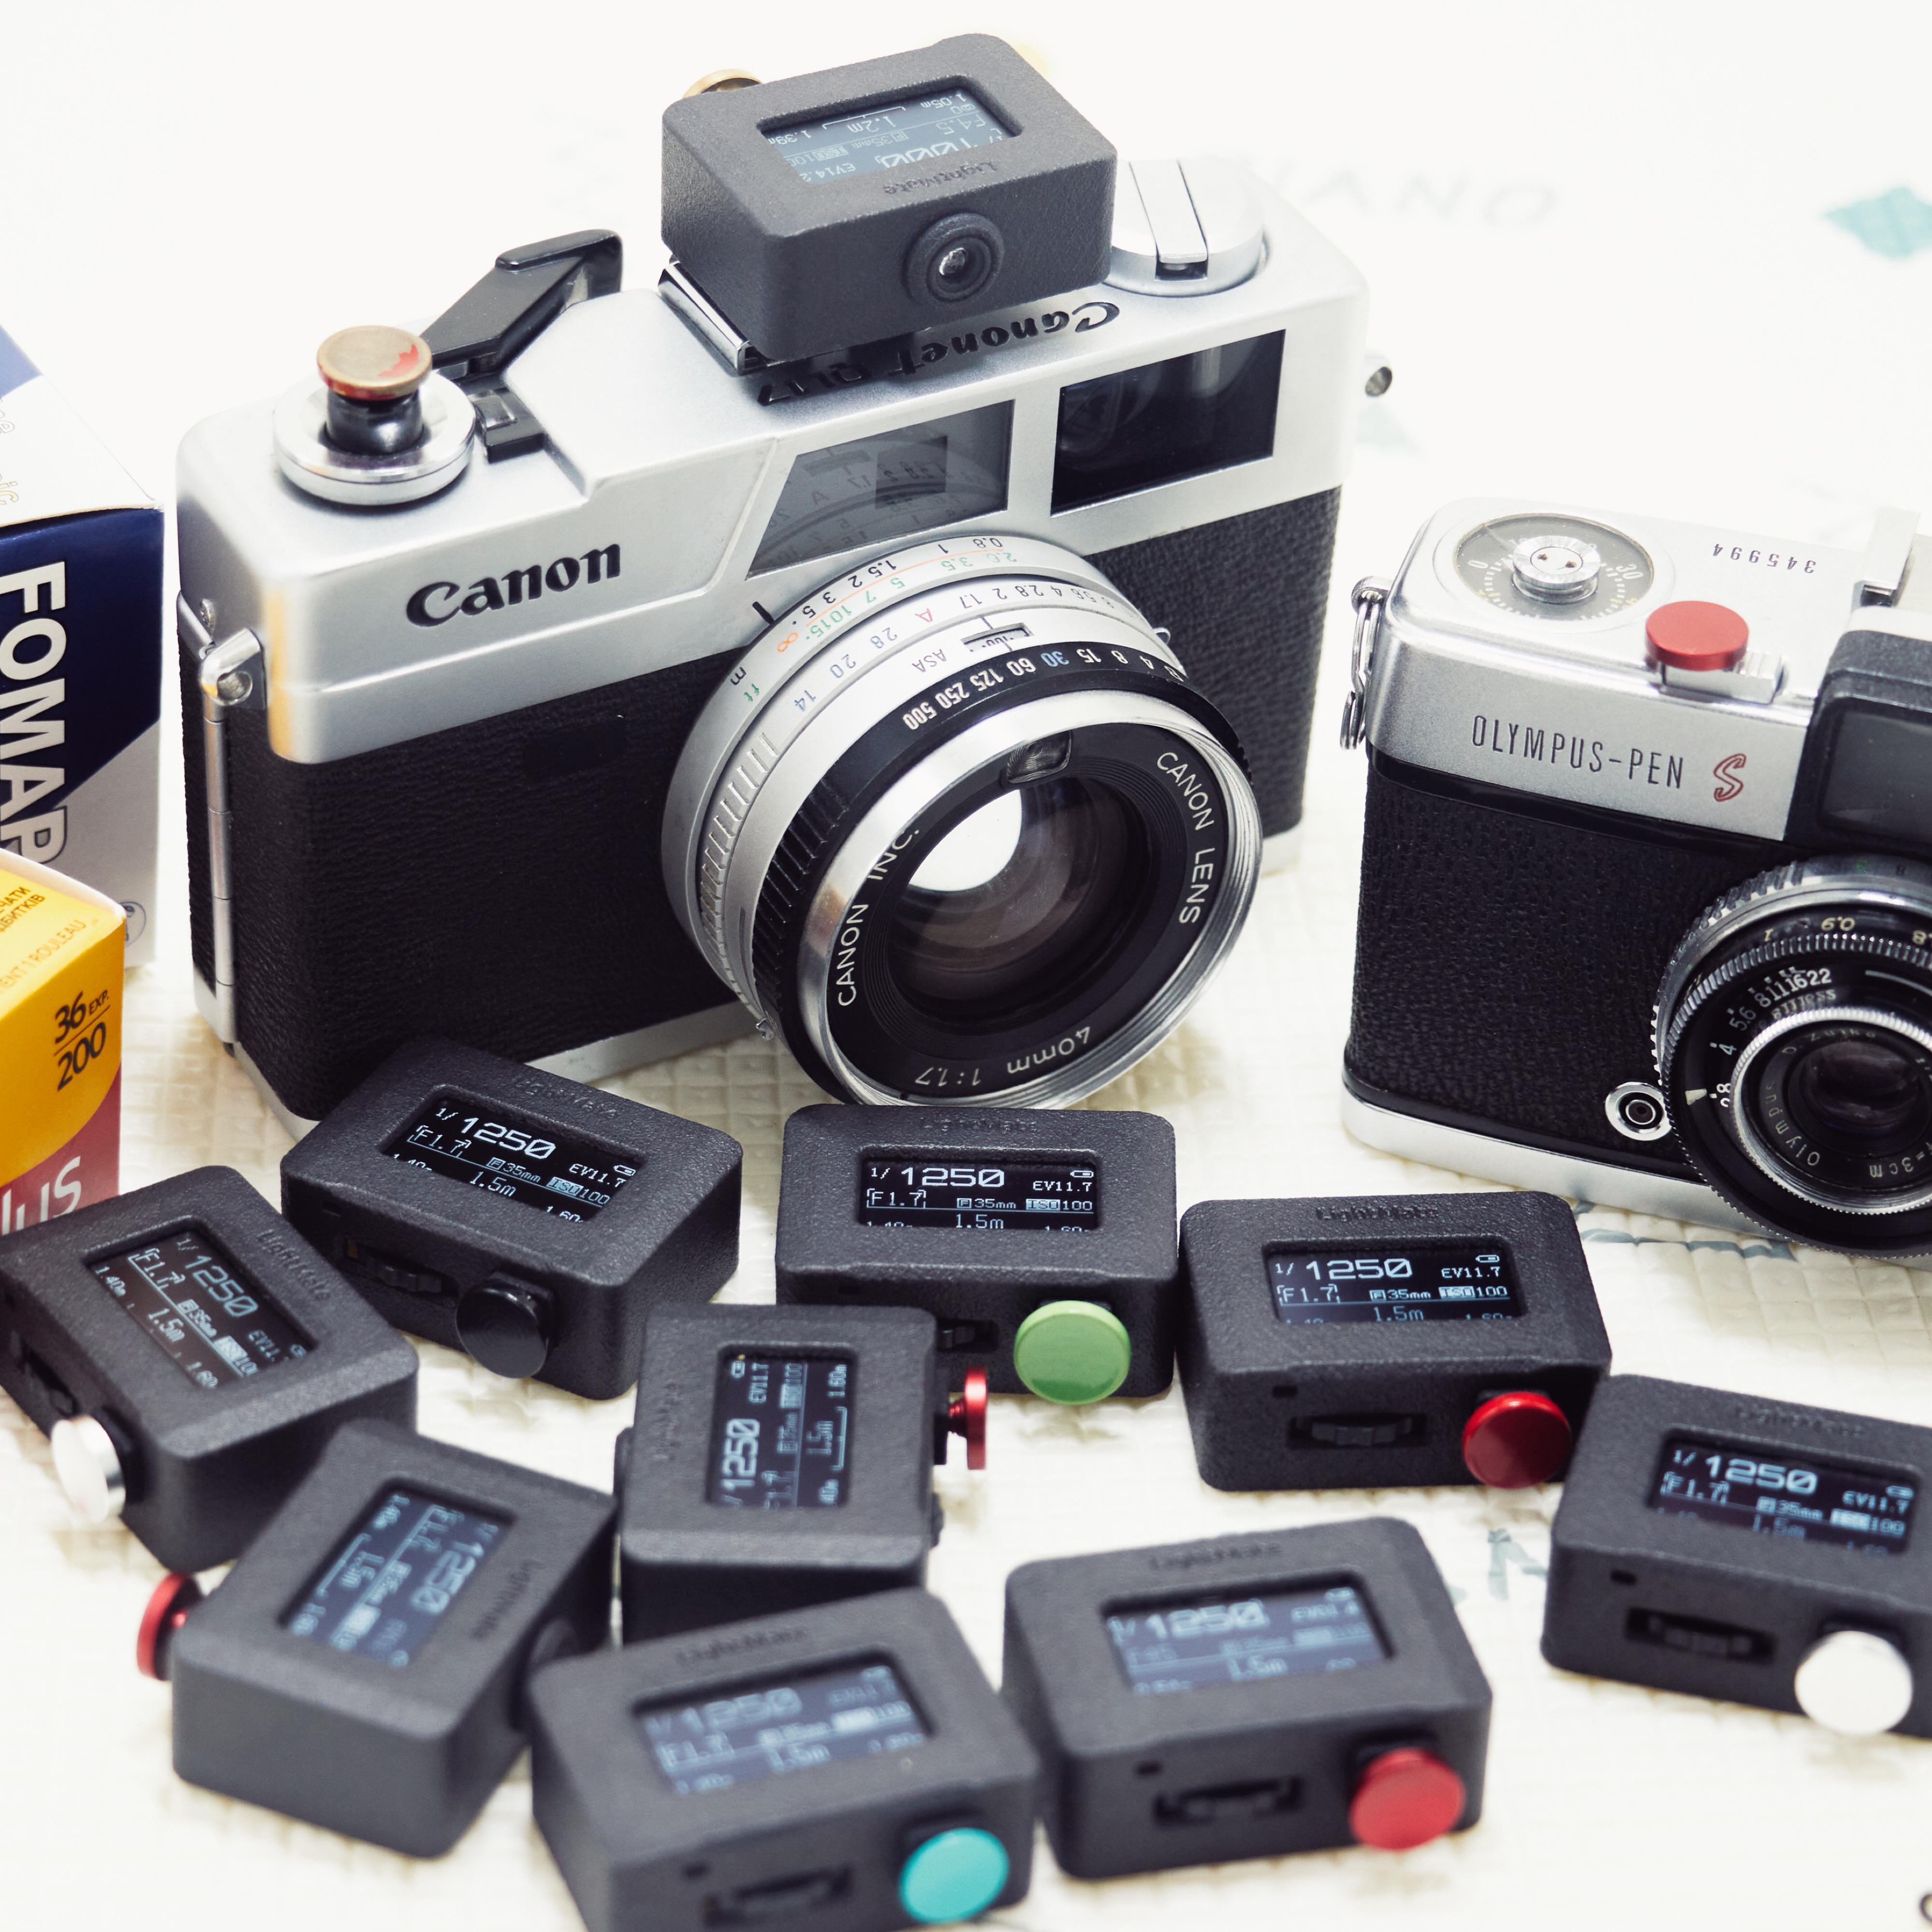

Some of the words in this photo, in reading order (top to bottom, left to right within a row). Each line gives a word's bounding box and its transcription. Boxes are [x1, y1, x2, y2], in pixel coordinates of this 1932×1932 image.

[847, 116, 897, 133] 1.2m
[936, 114, 986, 135] F4.5
[883, 161, 998, 194] LightMate
[888, 301, 1121, 378] Canonet
[937, 543, 949, 554] 1
[973, 537, 1004, 549] 0.8
[868, 559, 897, 579] 1.5
[940, 557, 973, 572] 3.5
[1712, 543, 1816, 575] 345994
[847, 575, 863, 588] 2
[1616, 564, 1645, 581] 30
[406, 543, 621, 627] Canon
[890, 577, 906, 590] 5
[992, 588, 1008, 600] 2
[1014, 584, 1045, 598] 2.8
[1051, 584, 1063, 597] 4
[822, 591, 837, 605] 3
[865, 590, 877, 604] 7
[801, 605, 817, 619] 5
[829, 605, 852, 624] 10
[916, 608, 934, 624] A
[869, 626, 899, 649] 28
[829, 653, 857, 679] 20
[911, 649, 948, 674] ASA
[1040, 651, 1070, 668] 30
[1076, 648, 1102, 663] 15
[1110, 650, 1129, 665] 8
[1138, 655, 1155, 670] 4
[1006, 657, 1037, 676] 60
[969, 668, 1005, 692] 125
[743, 683, 761, 702] ft
[794, 689, 818, 712] 14
[935, 682, 970, 709] 250
[902, 701, 938, 731] 500
[1471, 715, 1684, 790] OLYMPUS-PEN
[1713, 753, 1747, 802] S
[1156, 752, 1216, 831] CANON
[1179, 847, 1216, 924] LENS
[838, 903, 869, 1007] CANON
[868, 828, 920, 881] INC.
[28, 919, 87, 965] ROULEAU
[1806, 967, 1833, 986] 22
[1754, 992, 1772, 1008] 8
[55, 991, 85, 1045] 36
[88, 989, 110, 1015] EXP.
[1729, 1006, 1757, 1031] 5.6
[57, 1022, 107, 1093] 200
[1006, 1025, 1091, 1076] 40mm
[1719, 1043, 1737, 1056] 4
[1765, 1081, 1820, 1166] Olympus
[461, 1117, 557, 1160] 1250
[413, 1127, 467, 1154] F1.7
[502, 1163, 542, 1184] 35mm
[578, 1189, 611, 1206] 100
[568, 1163, 626, 1188] EV11.7
[469, 1171, 517, 1197] 1.5m
[901, 1167, 1005, 1188] 1250
[1032, 1180, 1093, 1193] EV11.7
[871, 1191, 923, 1208] F1.7
[974, 1198, 1017, 1209] 35mm
[1063, 1200, 1093, 1210] 100
[955, 1213, 1005, 1230] 1.5m
[1306, 1258, 1413, 1280] 1250
[1440, 1265, 1501, 1279] EV11.7
[185, 1255, 258, 1317] 1250
[1282, 1286, 1335, 1303] F1.7
[1387, 1288, 1431, 1300] 35mm
[1476, 1285, 1508, 1298] 100
[1373, 1305, 1425, 1322] 1.5m
[721, 1418, 760, 1491] 1250
[1705, 1454, 1819, 1495] 1250
[411, 1541, 484, 1616] 1250
